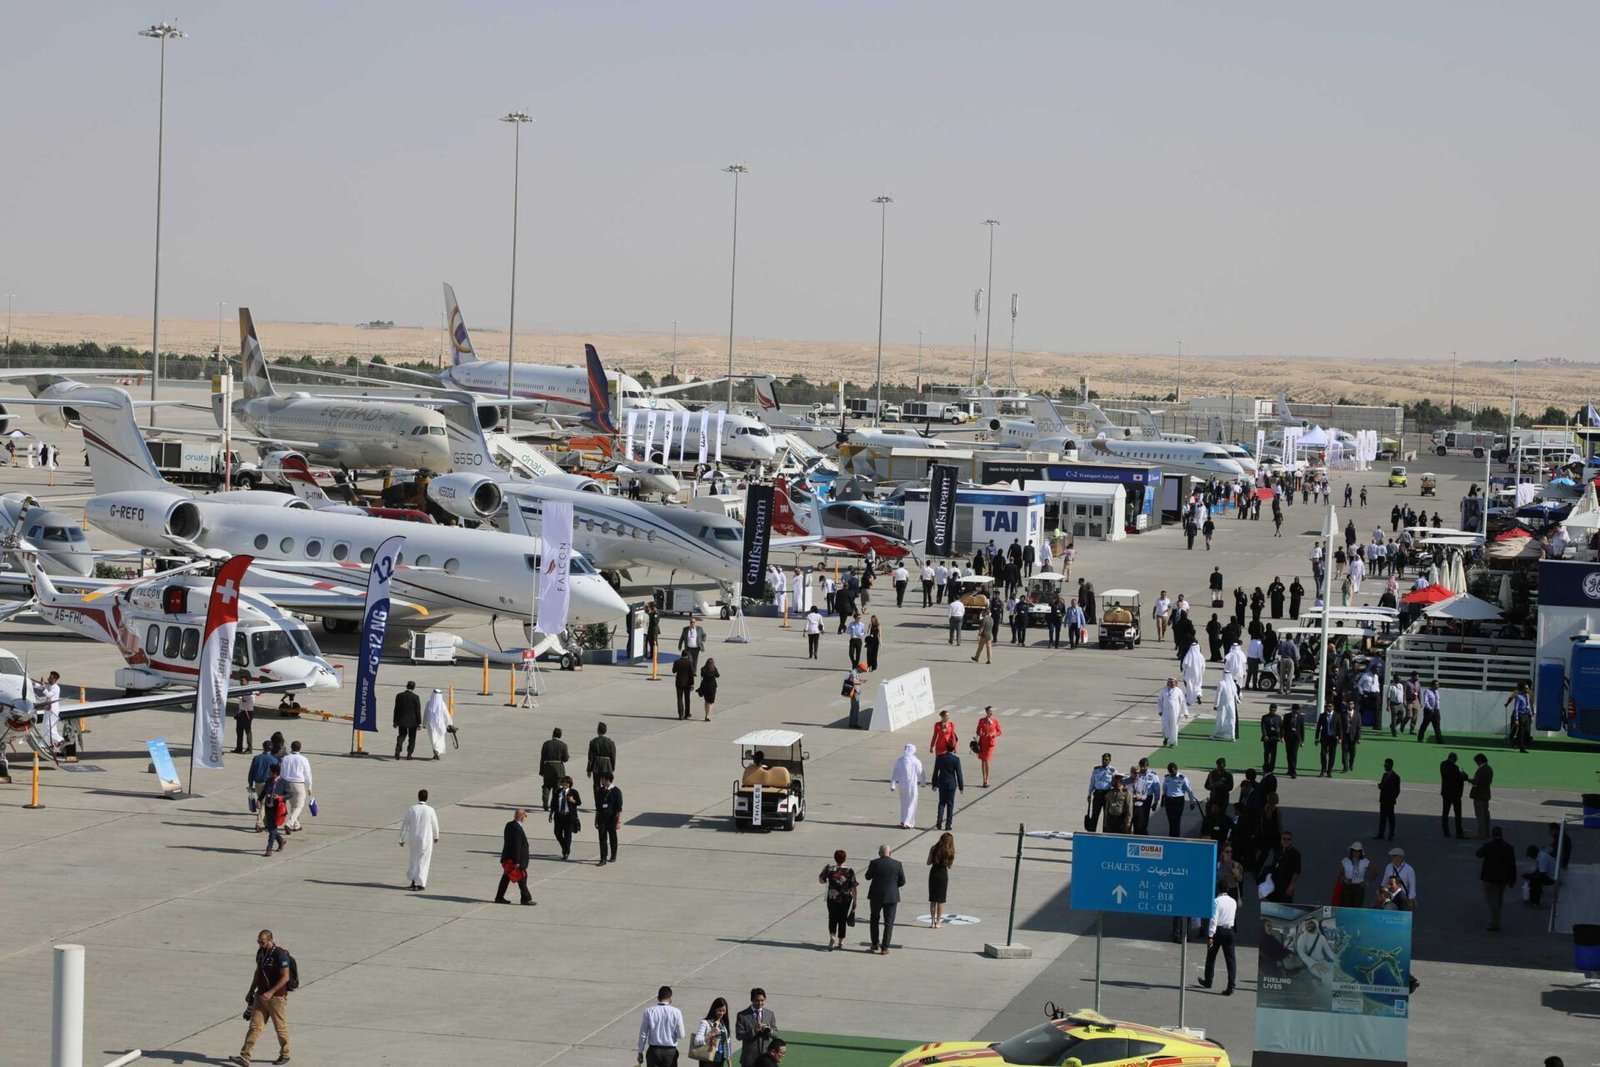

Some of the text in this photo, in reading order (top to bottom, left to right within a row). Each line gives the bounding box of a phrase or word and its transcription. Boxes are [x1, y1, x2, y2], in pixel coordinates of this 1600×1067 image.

[329, 405, 380, 421] ETIHAD
[184, 453, 210, 462] dnata
[453, 452, 483, 466] G550
[521, 454, 546, 476] dnata
[110, 504, 145, 522] G-REFO
[933, 476, 951, 546] Gulfstream
[982, 510, 1018, 533] TAI
[747, 499, 767, 585] Gulfstream
[373, 554, 395, 585] 12
[557, 542, 568, 592] FALCON
[135, 587, 161, 599] FALCON
[54, 608, 84, 625] A6-FHC
[370, 609, 388, 632] NG
[361, 686, 369, 716] PILATUS
[209, 721, 220, 763] Crafted
[1141, 845, 1162, 853] DUBAI
[1101, 861, 1141, 872] CHALETS
[1147, 866, 1188, 876] الشاليهات
[1139, 880, 1149, 889] A1
[1158, 881, 1174, 890] A20
[1138, 891, 1149, 900] B1
[1157, 891, 1174, 901] B18
[1138, 902, 1149, 911] C1
[1156, 903, 1173, 912] C13
[1263, 976, 1292, 985] FUELING
